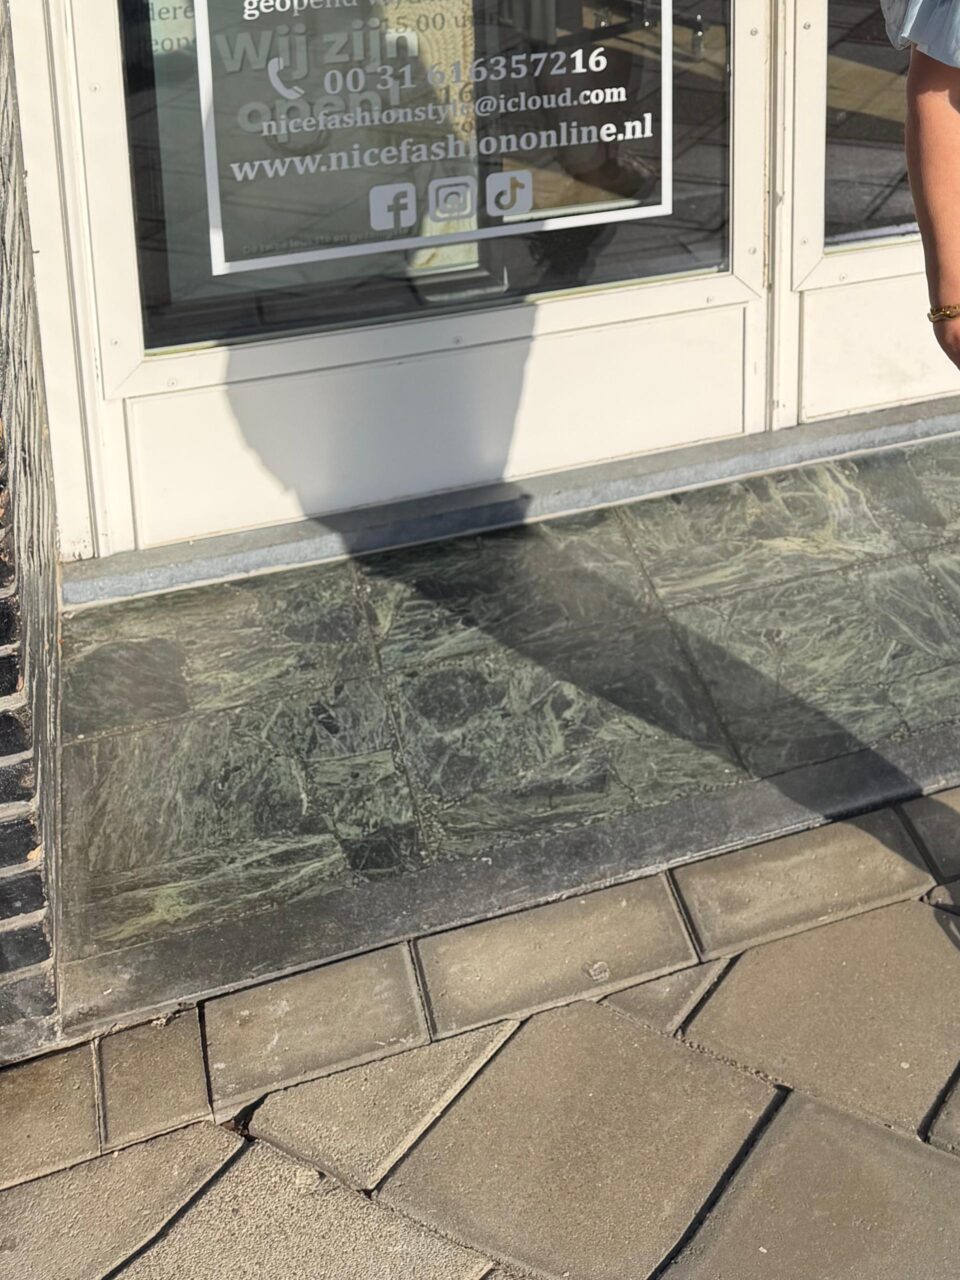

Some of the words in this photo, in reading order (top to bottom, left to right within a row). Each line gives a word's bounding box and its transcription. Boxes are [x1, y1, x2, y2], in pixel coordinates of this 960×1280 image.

[214, 23, 308, 80] Wij
[323, 17, 419, 72] zijn
[324, 67, 366, 94] 00
[376, 63, 416, 90] 31
[427, 46, 608, 87] 616357216
[230, 112, 653, 182] www.nicefashiononline.nl
